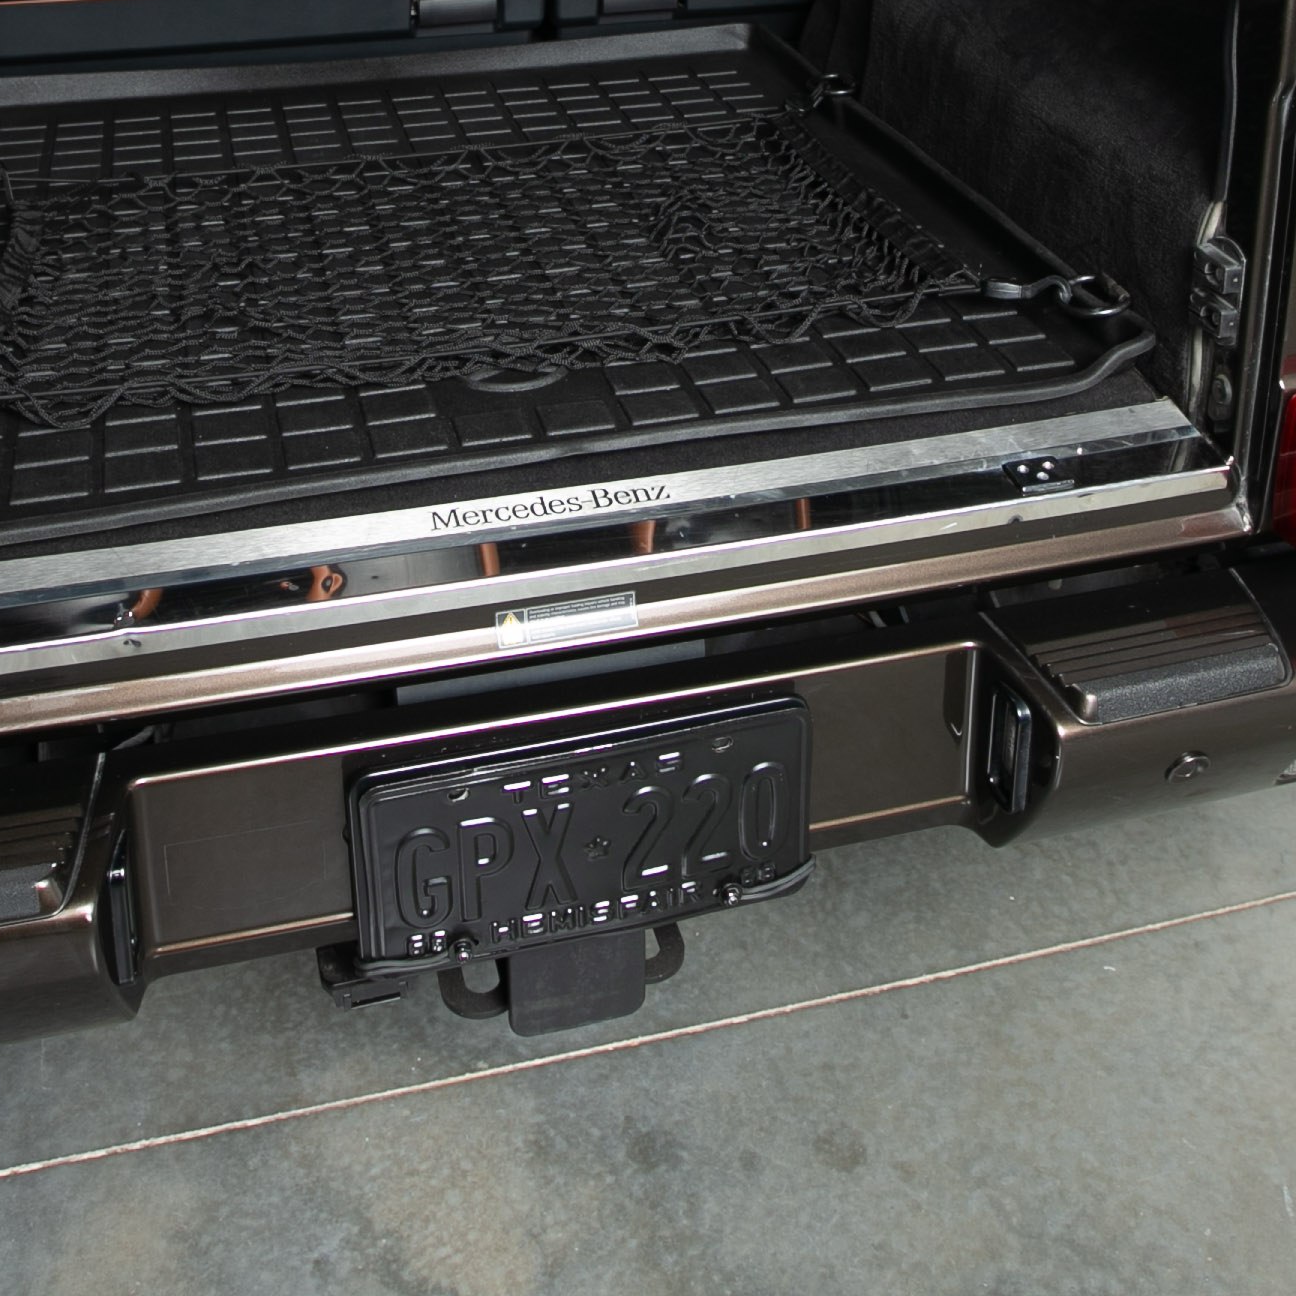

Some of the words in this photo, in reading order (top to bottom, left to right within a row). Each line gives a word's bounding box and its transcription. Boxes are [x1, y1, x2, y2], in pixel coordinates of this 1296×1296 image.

[431, 484, 670, 532] Mercedes-Benz
[501, 751, 683, 804] TEXAS
[394, 804, 580, 930] GPX
[621, 760, 790, 893] 220
[489, 880, 703, 944] HEMISFAIR
